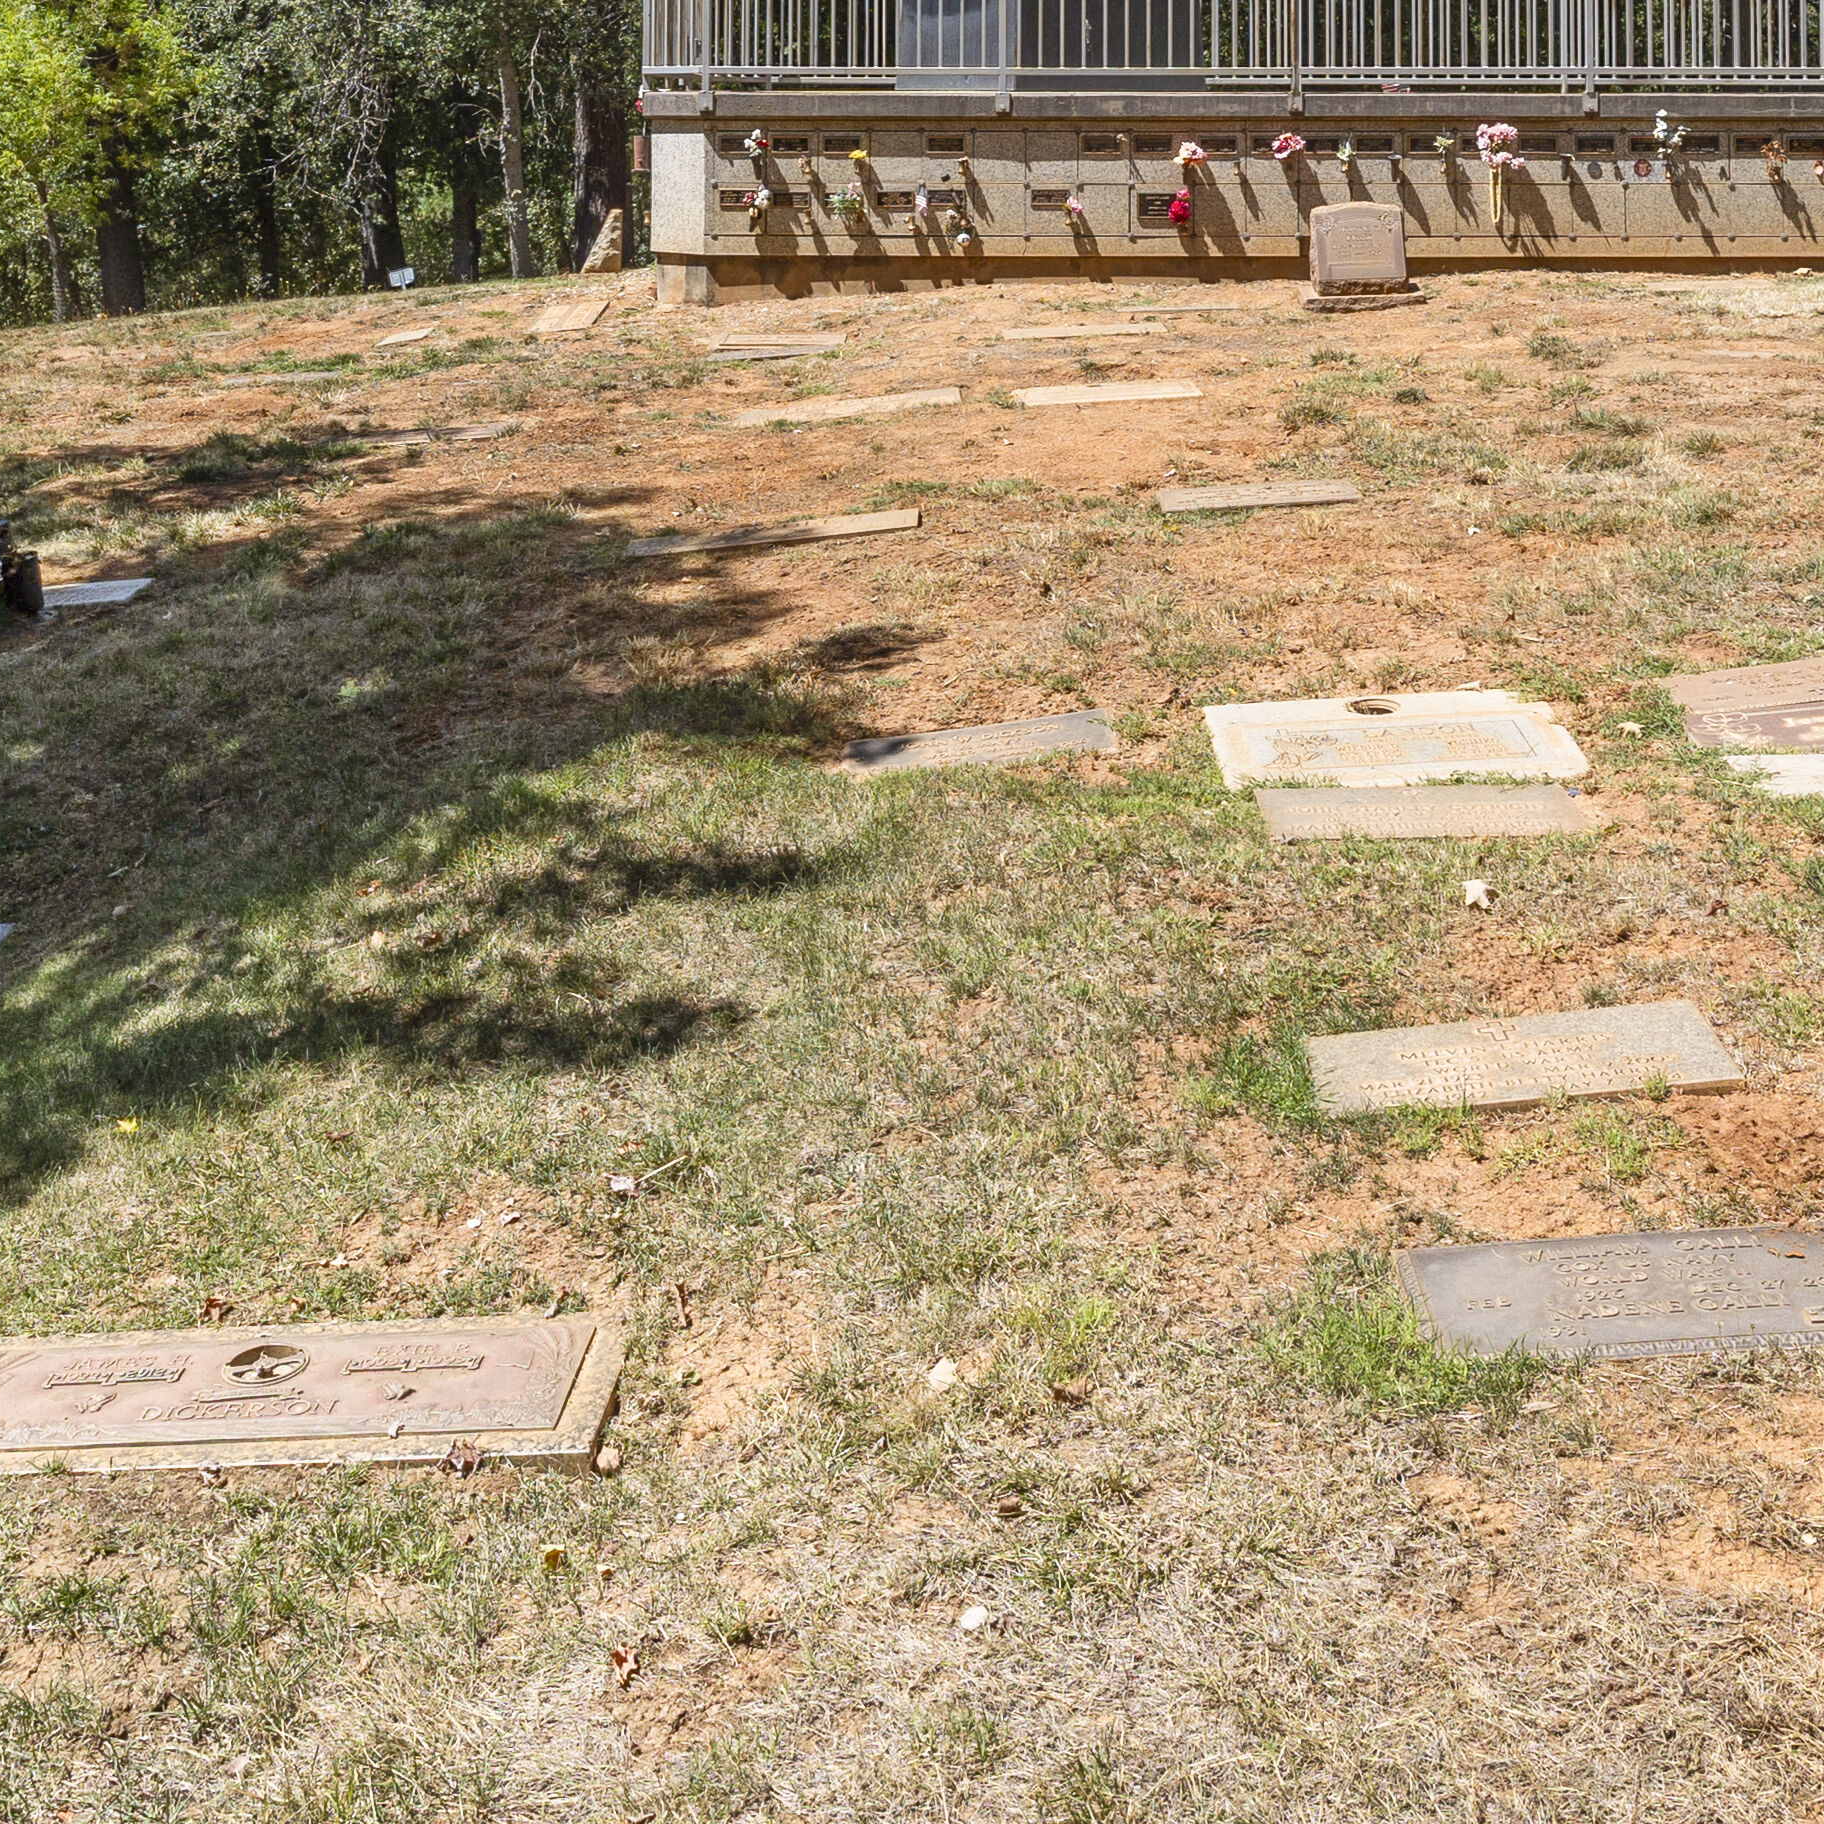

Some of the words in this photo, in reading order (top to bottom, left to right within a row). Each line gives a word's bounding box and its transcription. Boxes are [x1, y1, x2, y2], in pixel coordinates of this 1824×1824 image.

[981, 725, 1061, 738] DICKSON
[1363, 723, 1475, 738] LANDON
[1399, 1047, 1487, 1059] MELVIN
[1522, 1034, 1611, 1047] HARRIS
[1535, 1044, 1596, 1055] ARMY
[1433, 1061, 1510, 1074] WORLD
[1523, 1055, 1568, 1065] WAR
[1580, 1065, 1663, 1078] HARRIS
[1517, 1243, 1651, 1263] WILLIAM
[1673, 1235, 1764, 1253] GALLI
[1552, 1261, 1608, 1274] COX
[1620, 1258, 1653, 1270] US
[1662, 1253, 1740, 1266] NAVY
[1558, 1273, 1651, 1288] WORLD
[1662, 1268, 1722, 1281] WAR
[1463, 1297, 1513, 1311] FEB
[1689, 1281, 1743, 1295] DEC
[1759, 1278, 1789, 1291] 27
[1546, 1300, 1687, 1321] NADENE
[1690, 1293, 1793, 1312] GALLI
[63, 1356, 157, 1371] JAMES
[136, 1399, 339, 1422] DICKERSON
